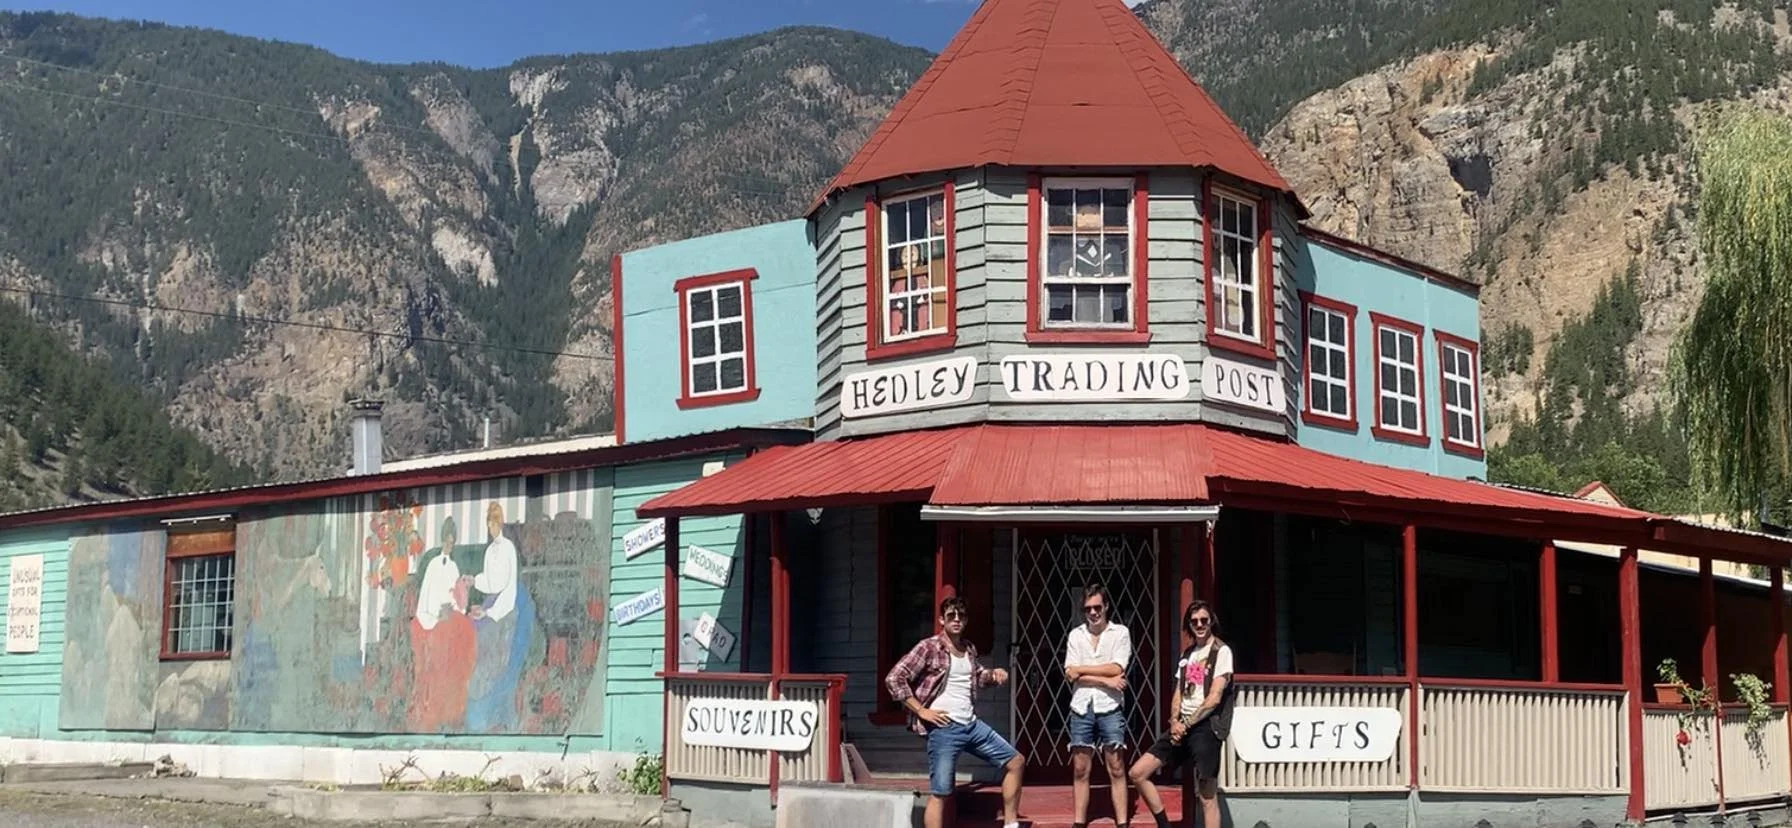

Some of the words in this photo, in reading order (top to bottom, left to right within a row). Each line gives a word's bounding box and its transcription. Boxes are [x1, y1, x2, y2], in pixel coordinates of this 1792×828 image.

[853, 362, 969, 410] HEDLEY
[1004, 359, 1180, 393] TRADING
[1215, 364, 1275, 406] POST
[625, 522, 665, 552] SHOWERS
[689, 547, 729, 584] WEDDINGS
[1070, 547, 1121, 566] CLOSED
[614, 591, 661, 621] BIRTHDAYS
[9, 624, 34, 639] PEOPLE
[687, 707, 812, 737] SOUVENIRS
[1261, 721, 1370, 750] GIFTS
